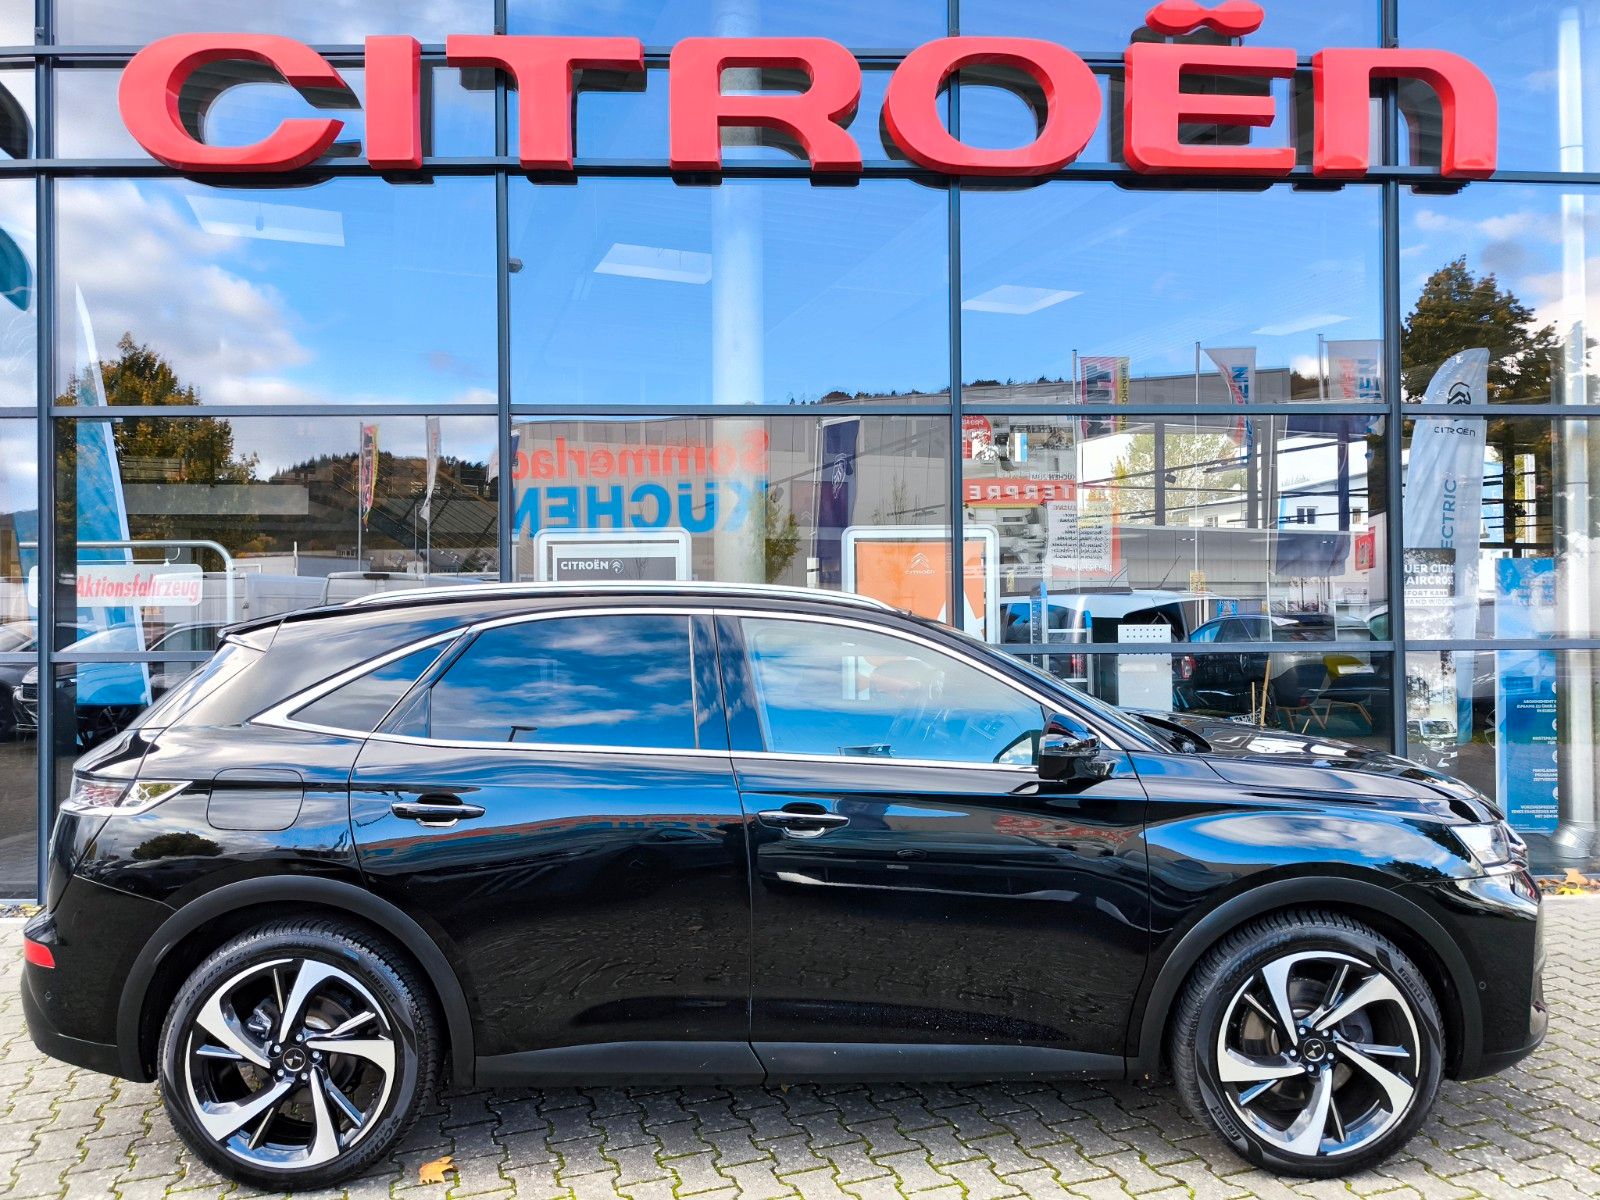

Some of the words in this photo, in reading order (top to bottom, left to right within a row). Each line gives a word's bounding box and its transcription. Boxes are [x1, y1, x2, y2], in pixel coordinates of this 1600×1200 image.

[119, 0, 1499, 177] CITROËN
[561, 559, 609, 570] CITROËN
[77, 573, 200, 601] Aktionsfahrzeug
[1397, 967, 1427, 1003] PIRELLI
[1210, 1106, 1242, 1142] PIRELLI
